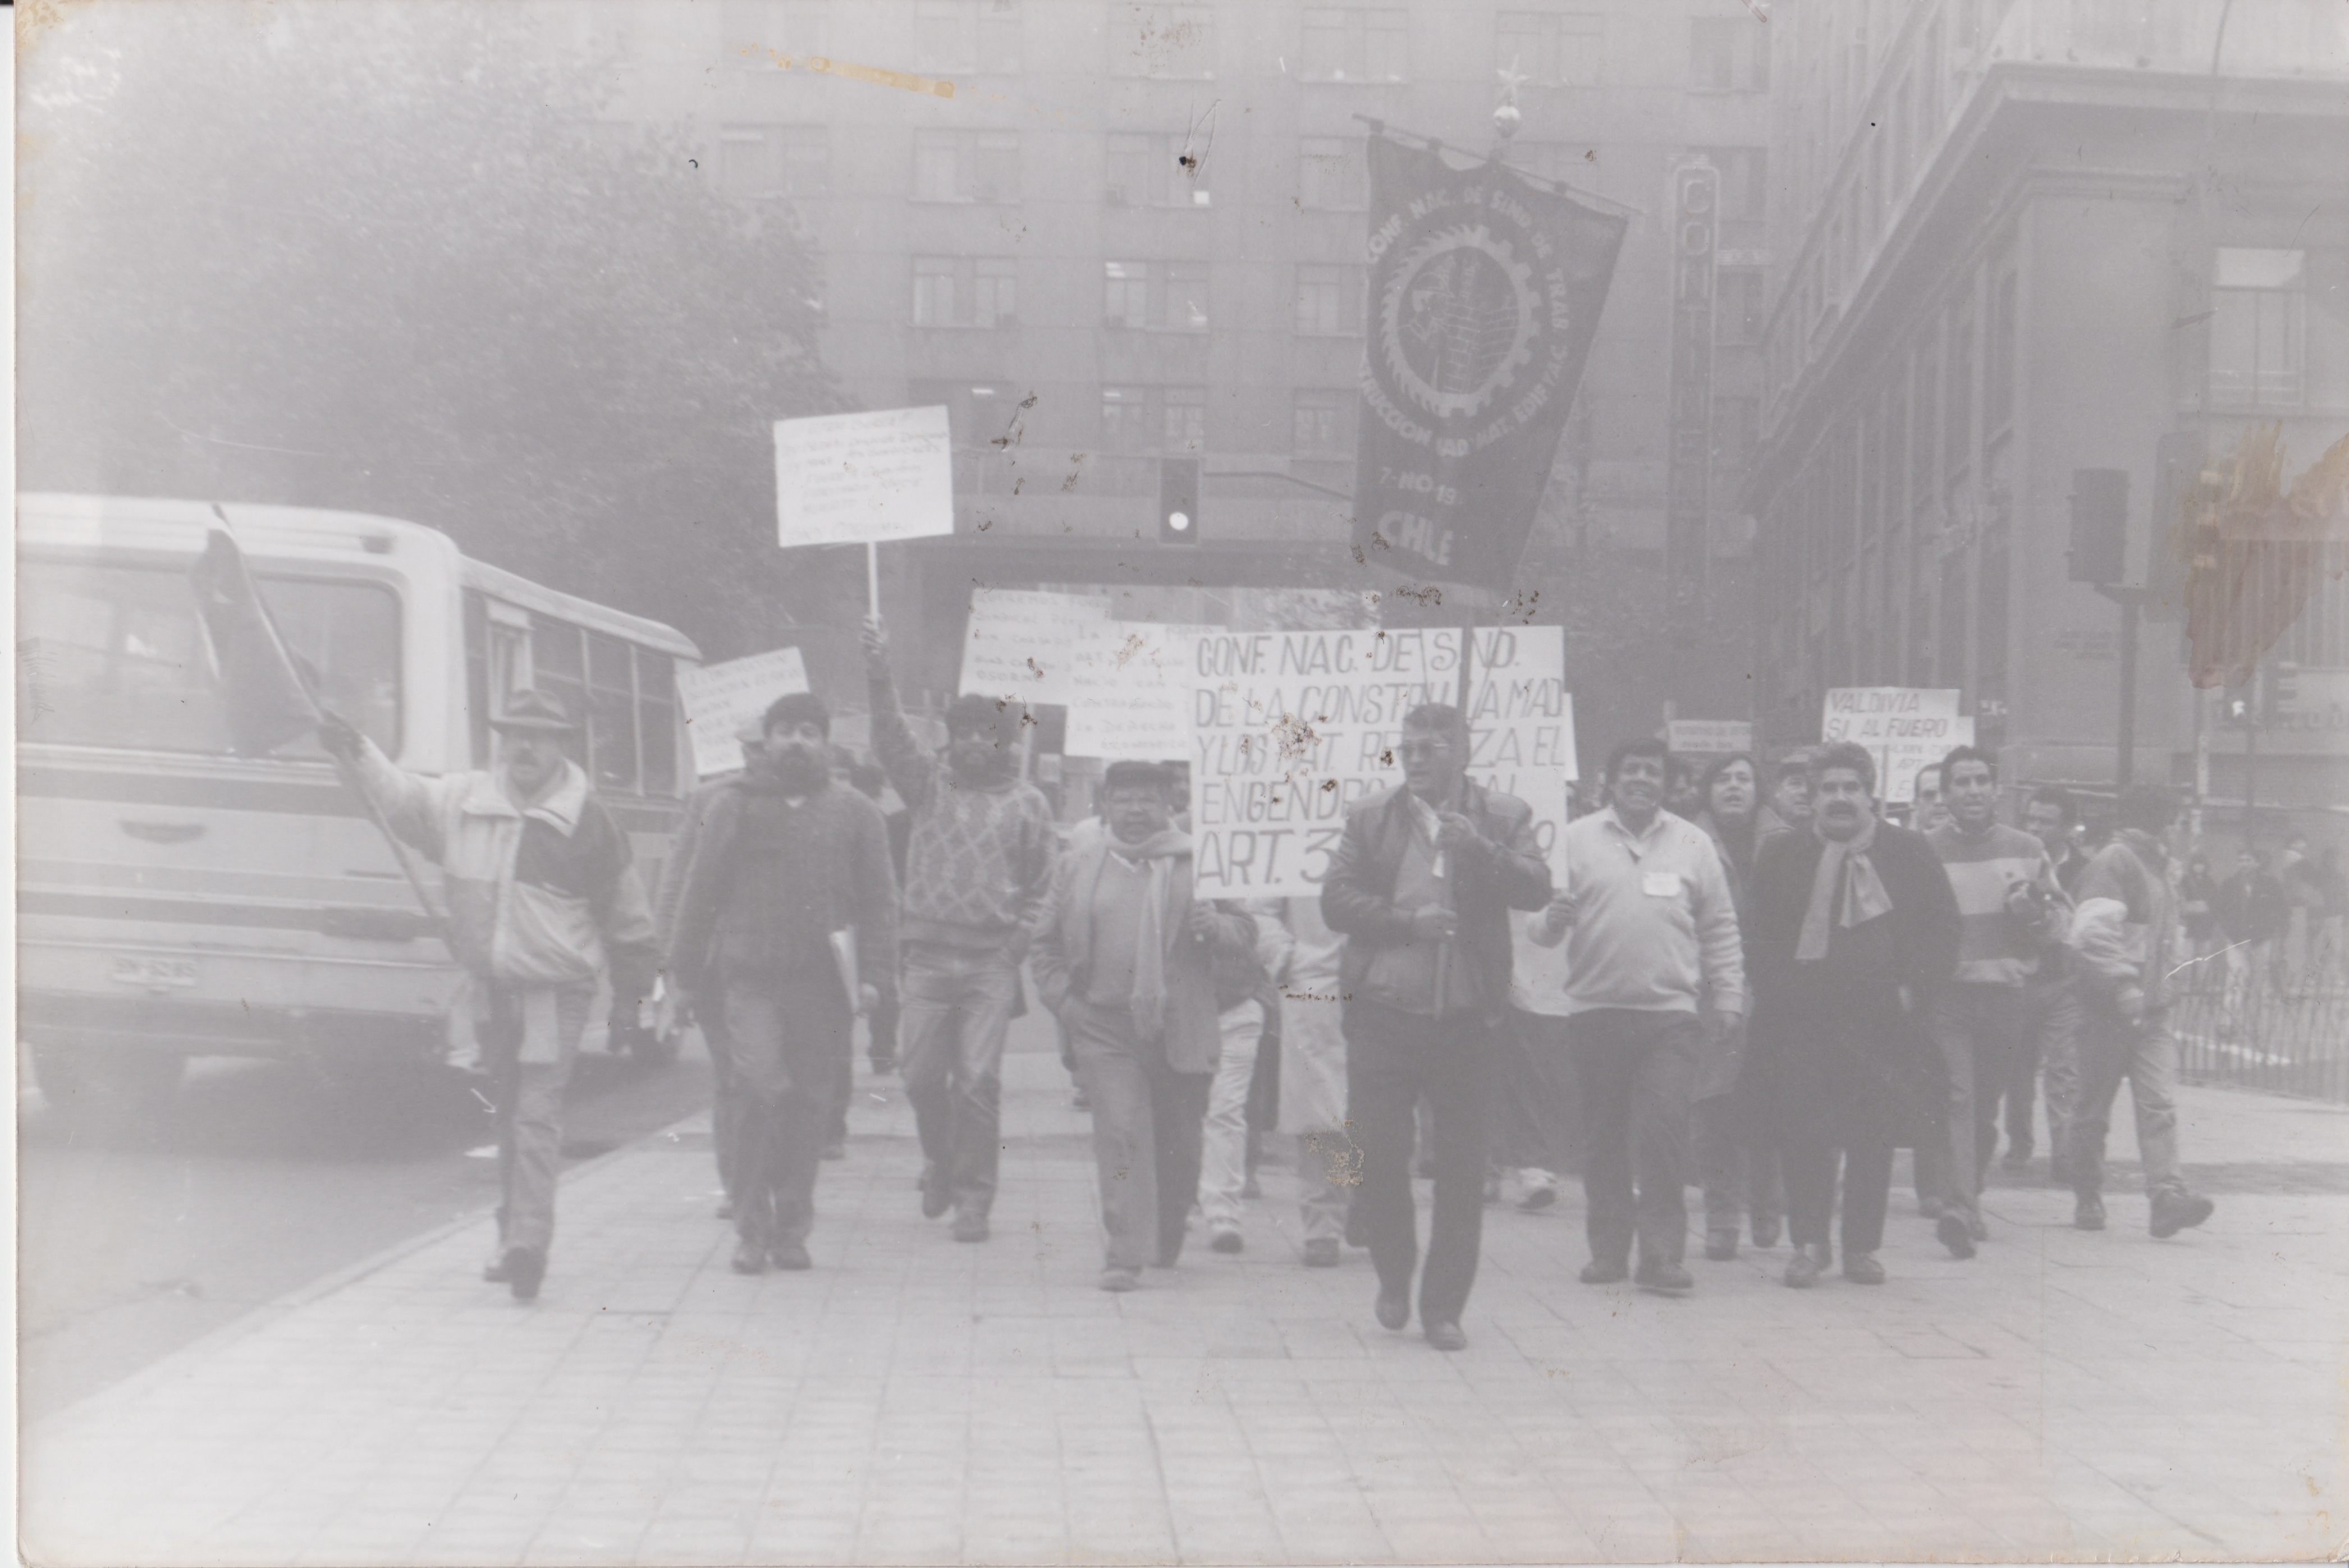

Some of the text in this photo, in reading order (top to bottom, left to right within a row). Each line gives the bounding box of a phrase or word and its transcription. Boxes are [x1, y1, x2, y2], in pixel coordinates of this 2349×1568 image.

[1463, 185, 1483, 204] DE
[1531, 232, 1553, 259] DE
[1377, 510, 1454, 566] CHLE
[1197, 635, 1272, 677] CONF.
[1279, 634, 1358, 676] NAC.
[1372, 631, 1420, 672] DE
[1430, 630, 1519, 672] SND.
[1196, 686, 1233, 728] DE
[1244, 686, 1285, 727] LA
[1830, 691, 1920, 713] VALDIVIA
[1533, 725, 1566, 768] EL
[1826, 717, 1948, 742] SI AL FUERO
[1194, 828, 1295, 887] ART.
